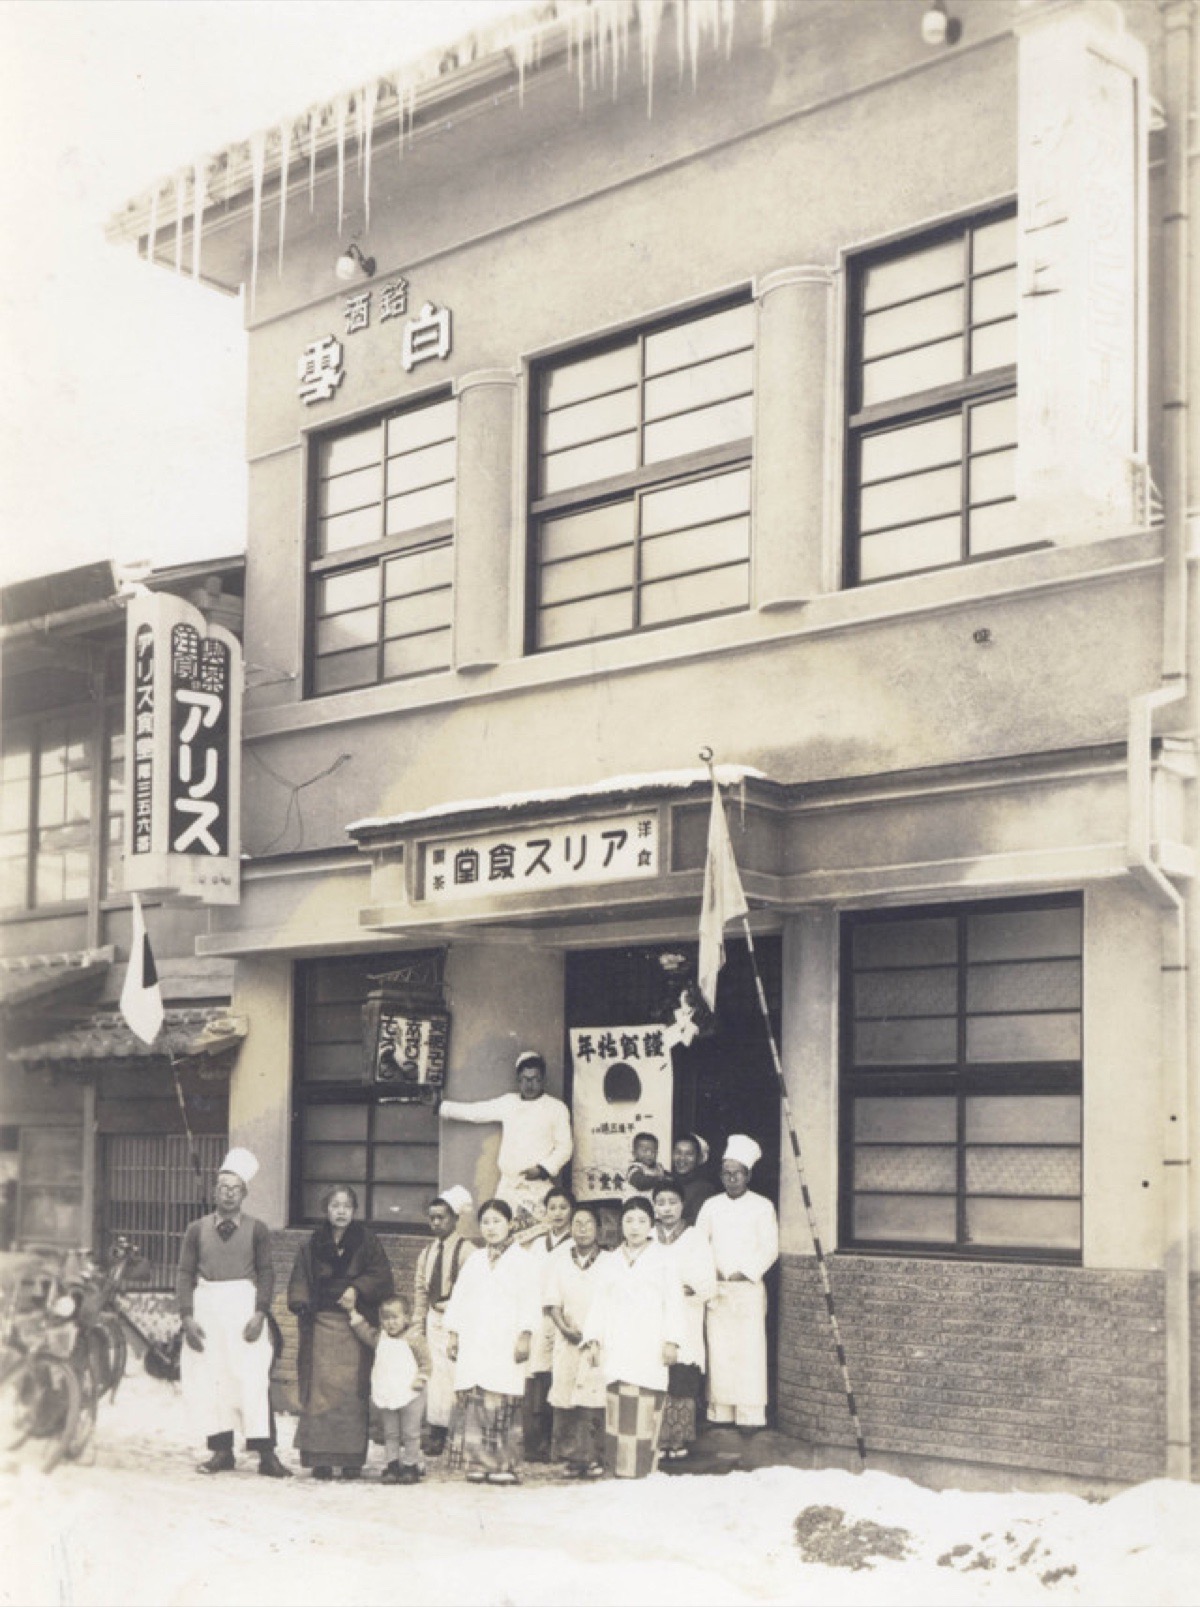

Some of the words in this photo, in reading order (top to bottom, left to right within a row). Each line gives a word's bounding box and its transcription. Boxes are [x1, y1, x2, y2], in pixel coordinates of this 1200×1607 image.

[345, 277, 409, 335] 銘酒
[298, 301, 452, 406] 白雪
[174, 690, 221, 855] アリス
[454, 830, 628, 885] アリス食堂
[638, 820, 652, 867] 洋食
